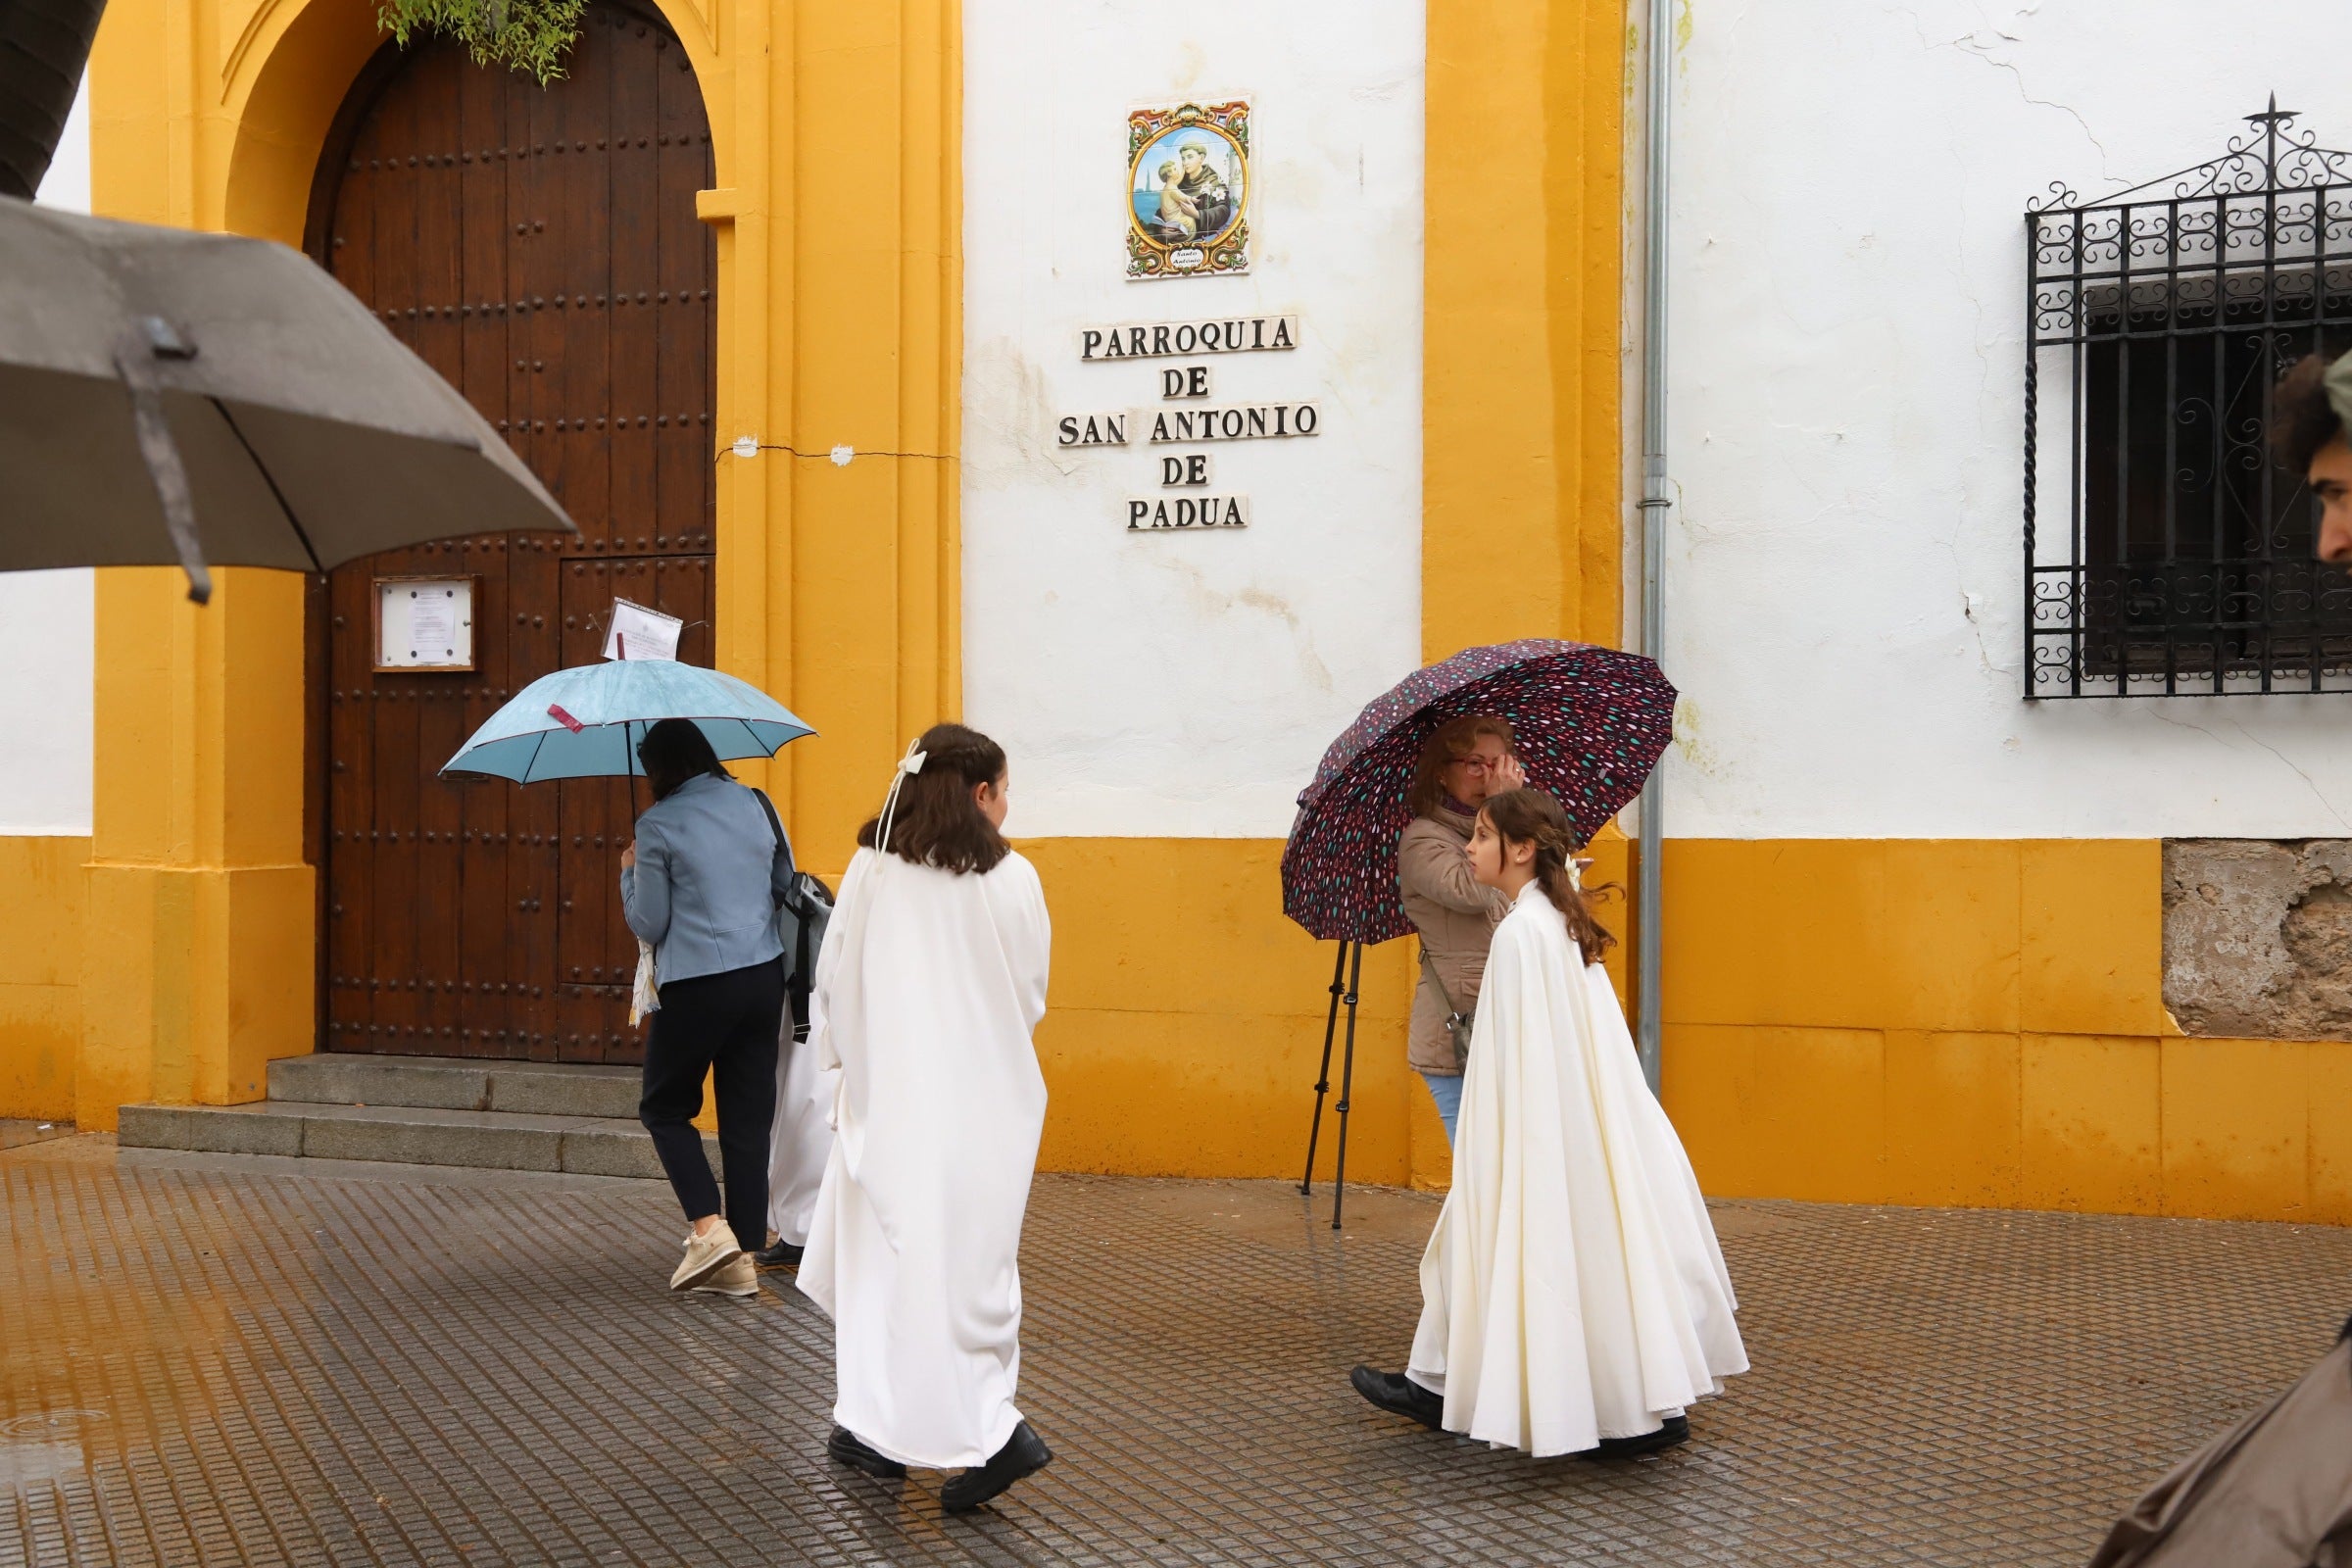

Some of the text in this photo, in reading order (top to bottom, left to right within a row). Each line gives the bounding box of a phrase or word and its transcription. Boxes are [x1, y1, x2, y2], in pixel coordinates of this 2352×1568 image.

[1082, 318, 1294, 359] PARROQUIA
[1163, 366, 1208, 397] DE
[1058, 405, 1317, 445] SAN ANTONIO
[1162, 455, 1207, 485] DE
[1127, 497, 1245, 529] PADUA
